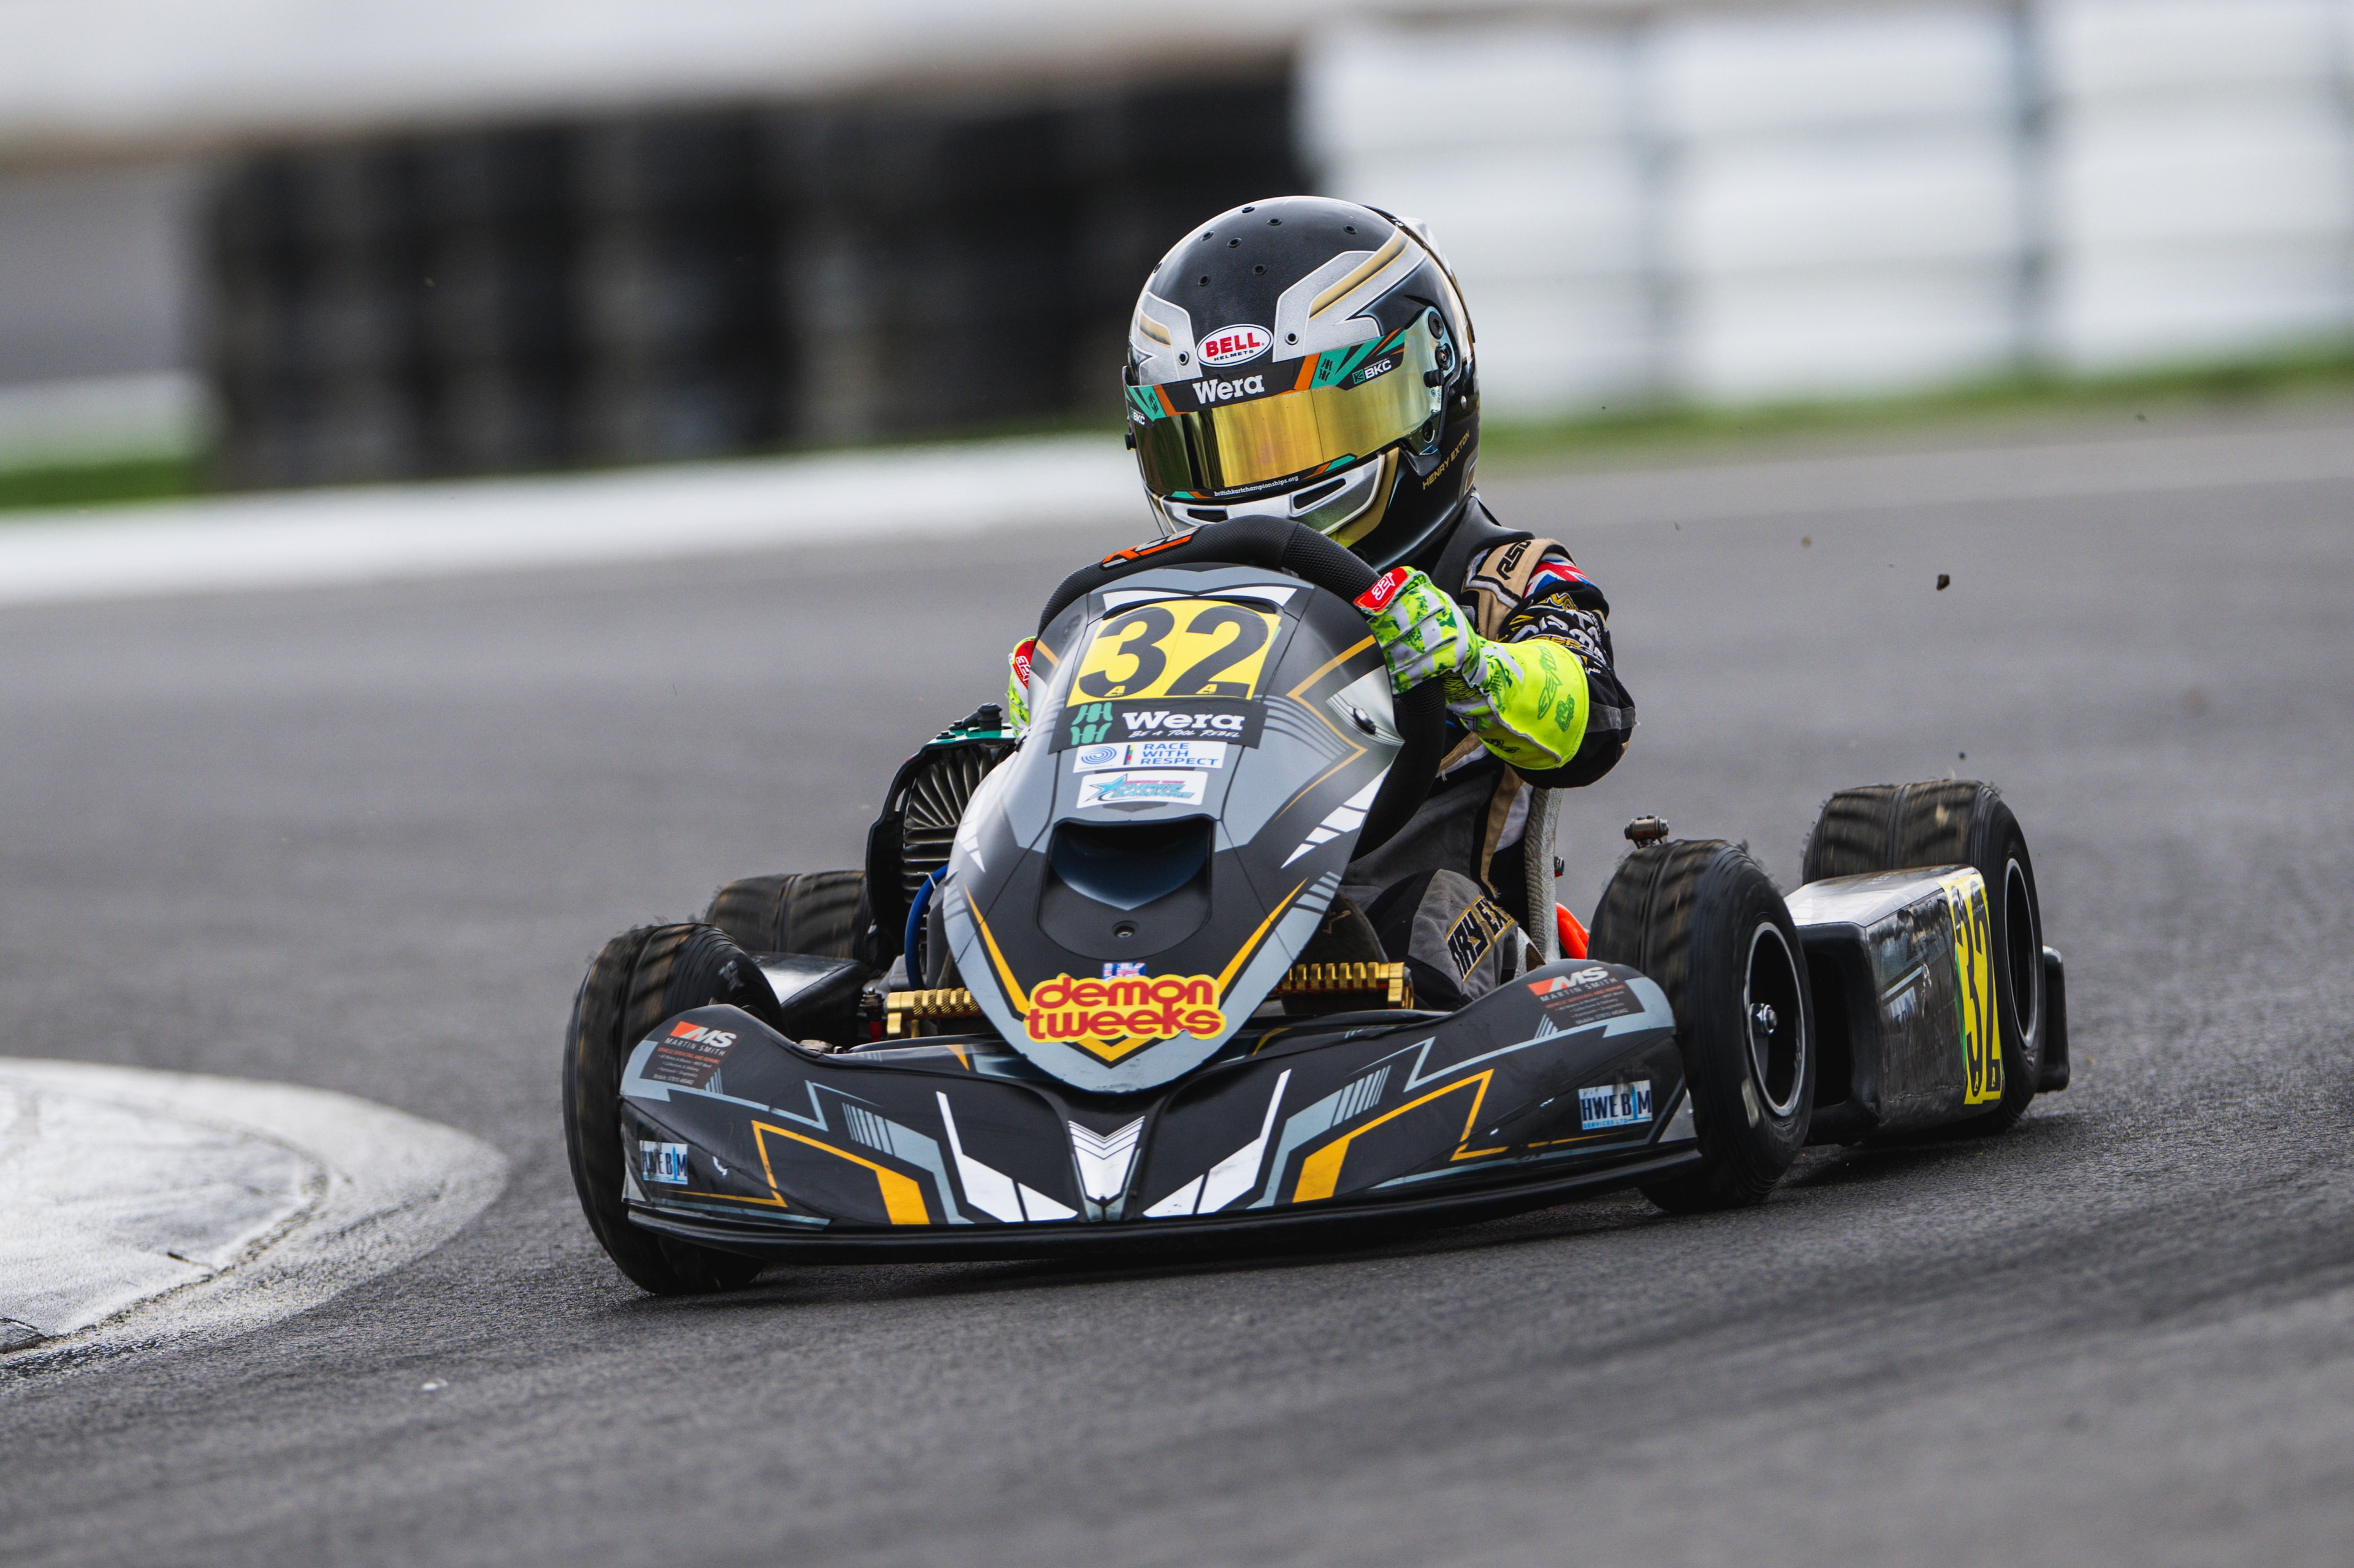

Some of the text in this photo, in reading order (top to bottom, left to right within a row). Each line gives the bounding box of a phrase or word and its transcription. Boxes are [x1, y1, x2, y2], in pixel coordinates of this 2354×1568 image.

[1206, 332, 1260, 357] BELL
[1214, 349, 1254, 361] HELMETS
[1364, 360, 1392, 379] BKC
[1192, 375, 1265, 405] Wera
[1422, 430, 1469, 490] HENRY EXTON
[1214, 476, 1298, 497] britishkartchampionships.org
[1079, 605, 1269, 699] 32
[1122, 711, 1245, 731] Wera
[1540, 986, 1582, 1002] MARTIN
[1585, 977, 1618, 989] SMITH
[1549, 967, 1609, 992] MS
[1951, 879, 2001, 1098] 32
[1034, 977, 1214, 1008] demon
[1025, 1005, 1221, 1040] tweeks
[665, 1037, 726, 1056] MARTIN SMITH
[679, 1026, 737, 1048] MS
[1581, 1095, 1619, 1121] HWE
